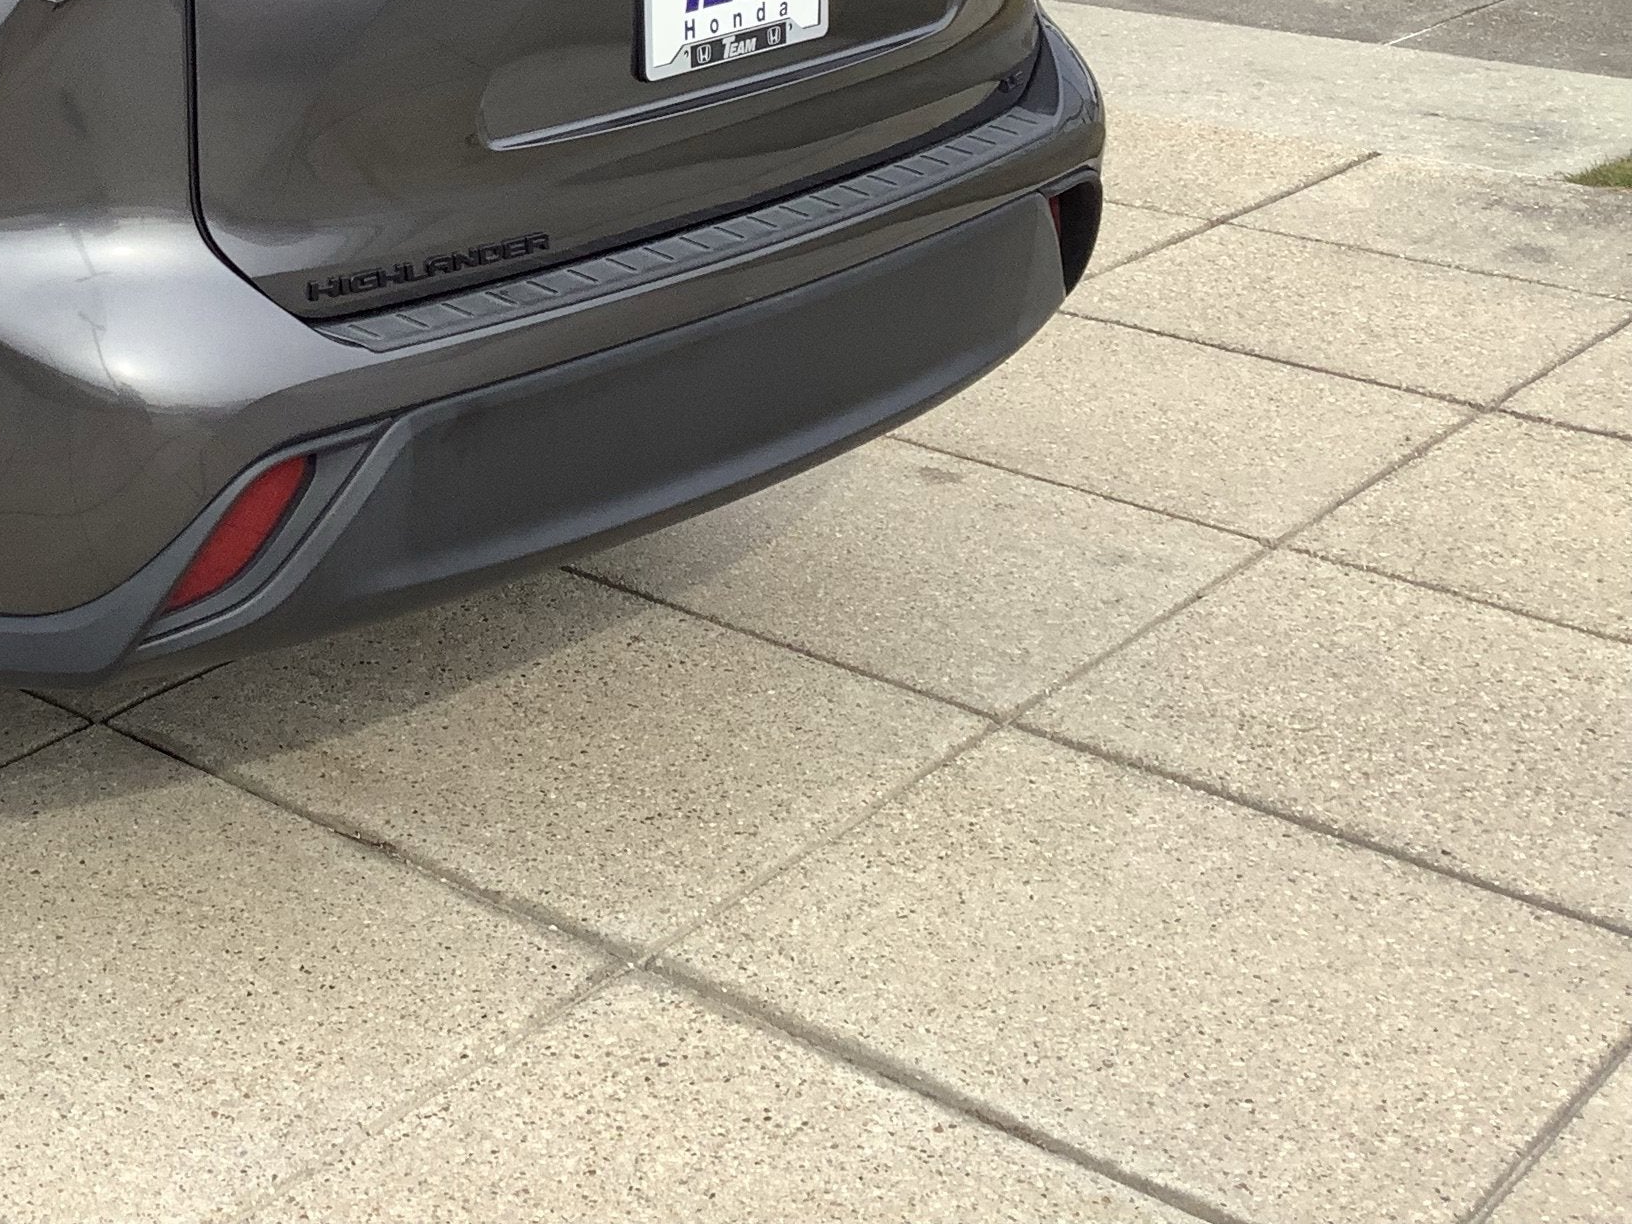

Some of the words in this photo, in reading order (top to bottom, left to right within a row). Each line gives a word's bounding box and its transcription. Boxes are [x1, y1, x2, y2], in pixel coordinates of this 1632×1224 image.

[684, 1, 788, 41] Honda
[722, 36, 757, 60] TEAM
[305, 231, 551, 302] HIGHLANDER
